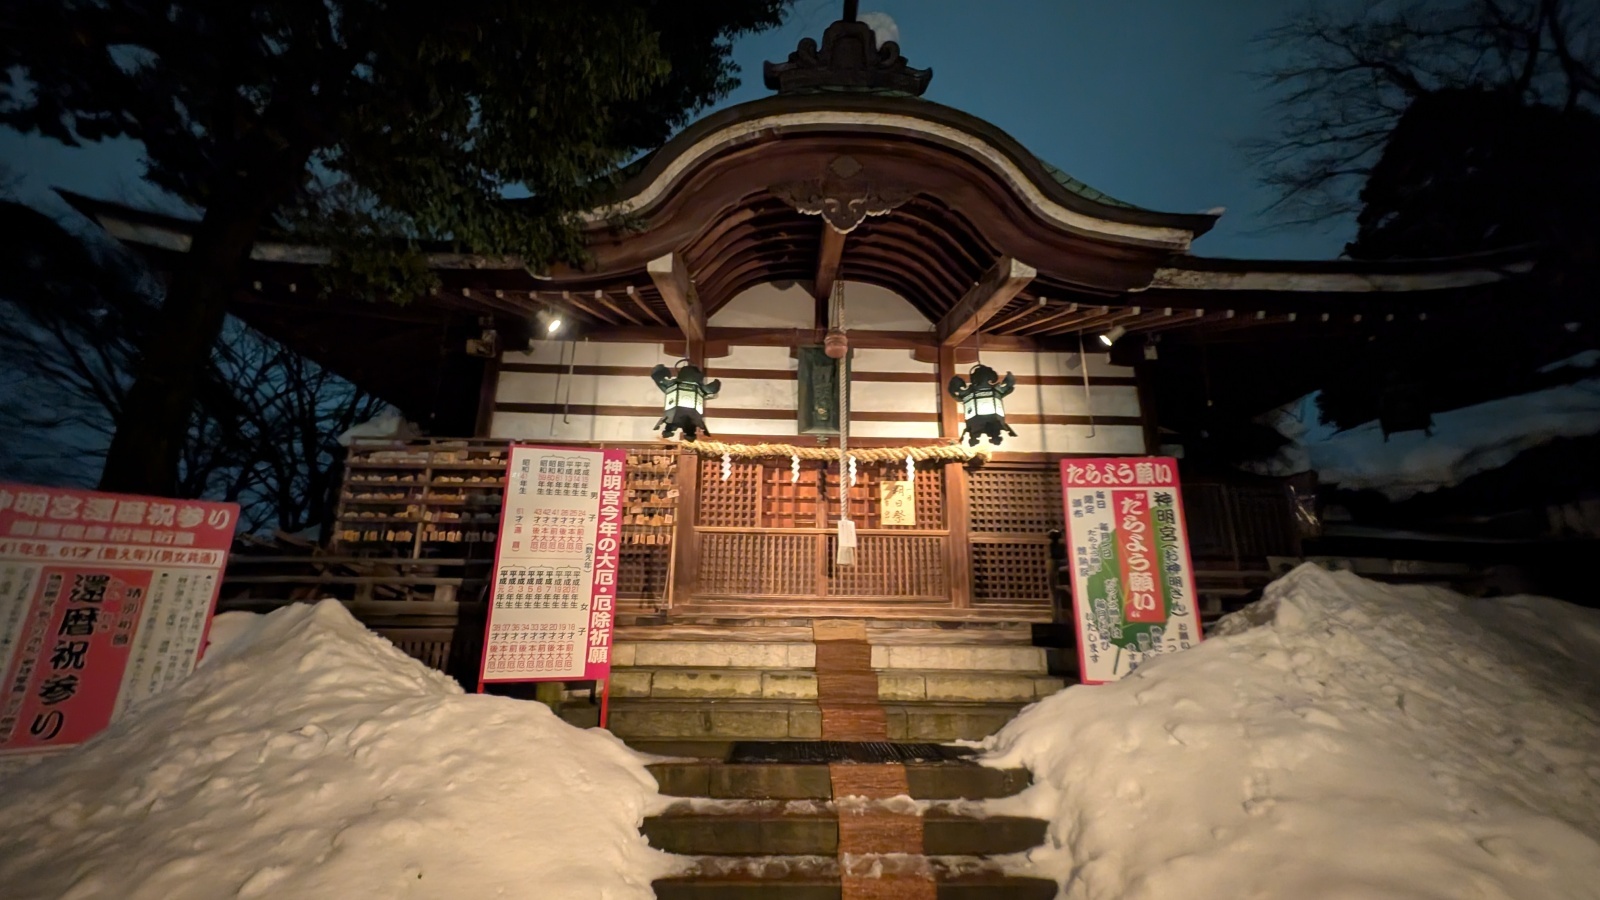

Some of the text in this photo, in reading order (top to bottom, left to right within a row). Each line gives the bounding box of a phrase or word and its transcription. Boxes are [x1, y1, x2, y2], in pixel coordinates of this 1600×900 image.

[1066, 462, 1172, 485] たらよう願い
[588, 459, 622, 663] 神明宮今年の大厄・厄除祈願
[30, 573, 110, 741] 還暦祝参り
